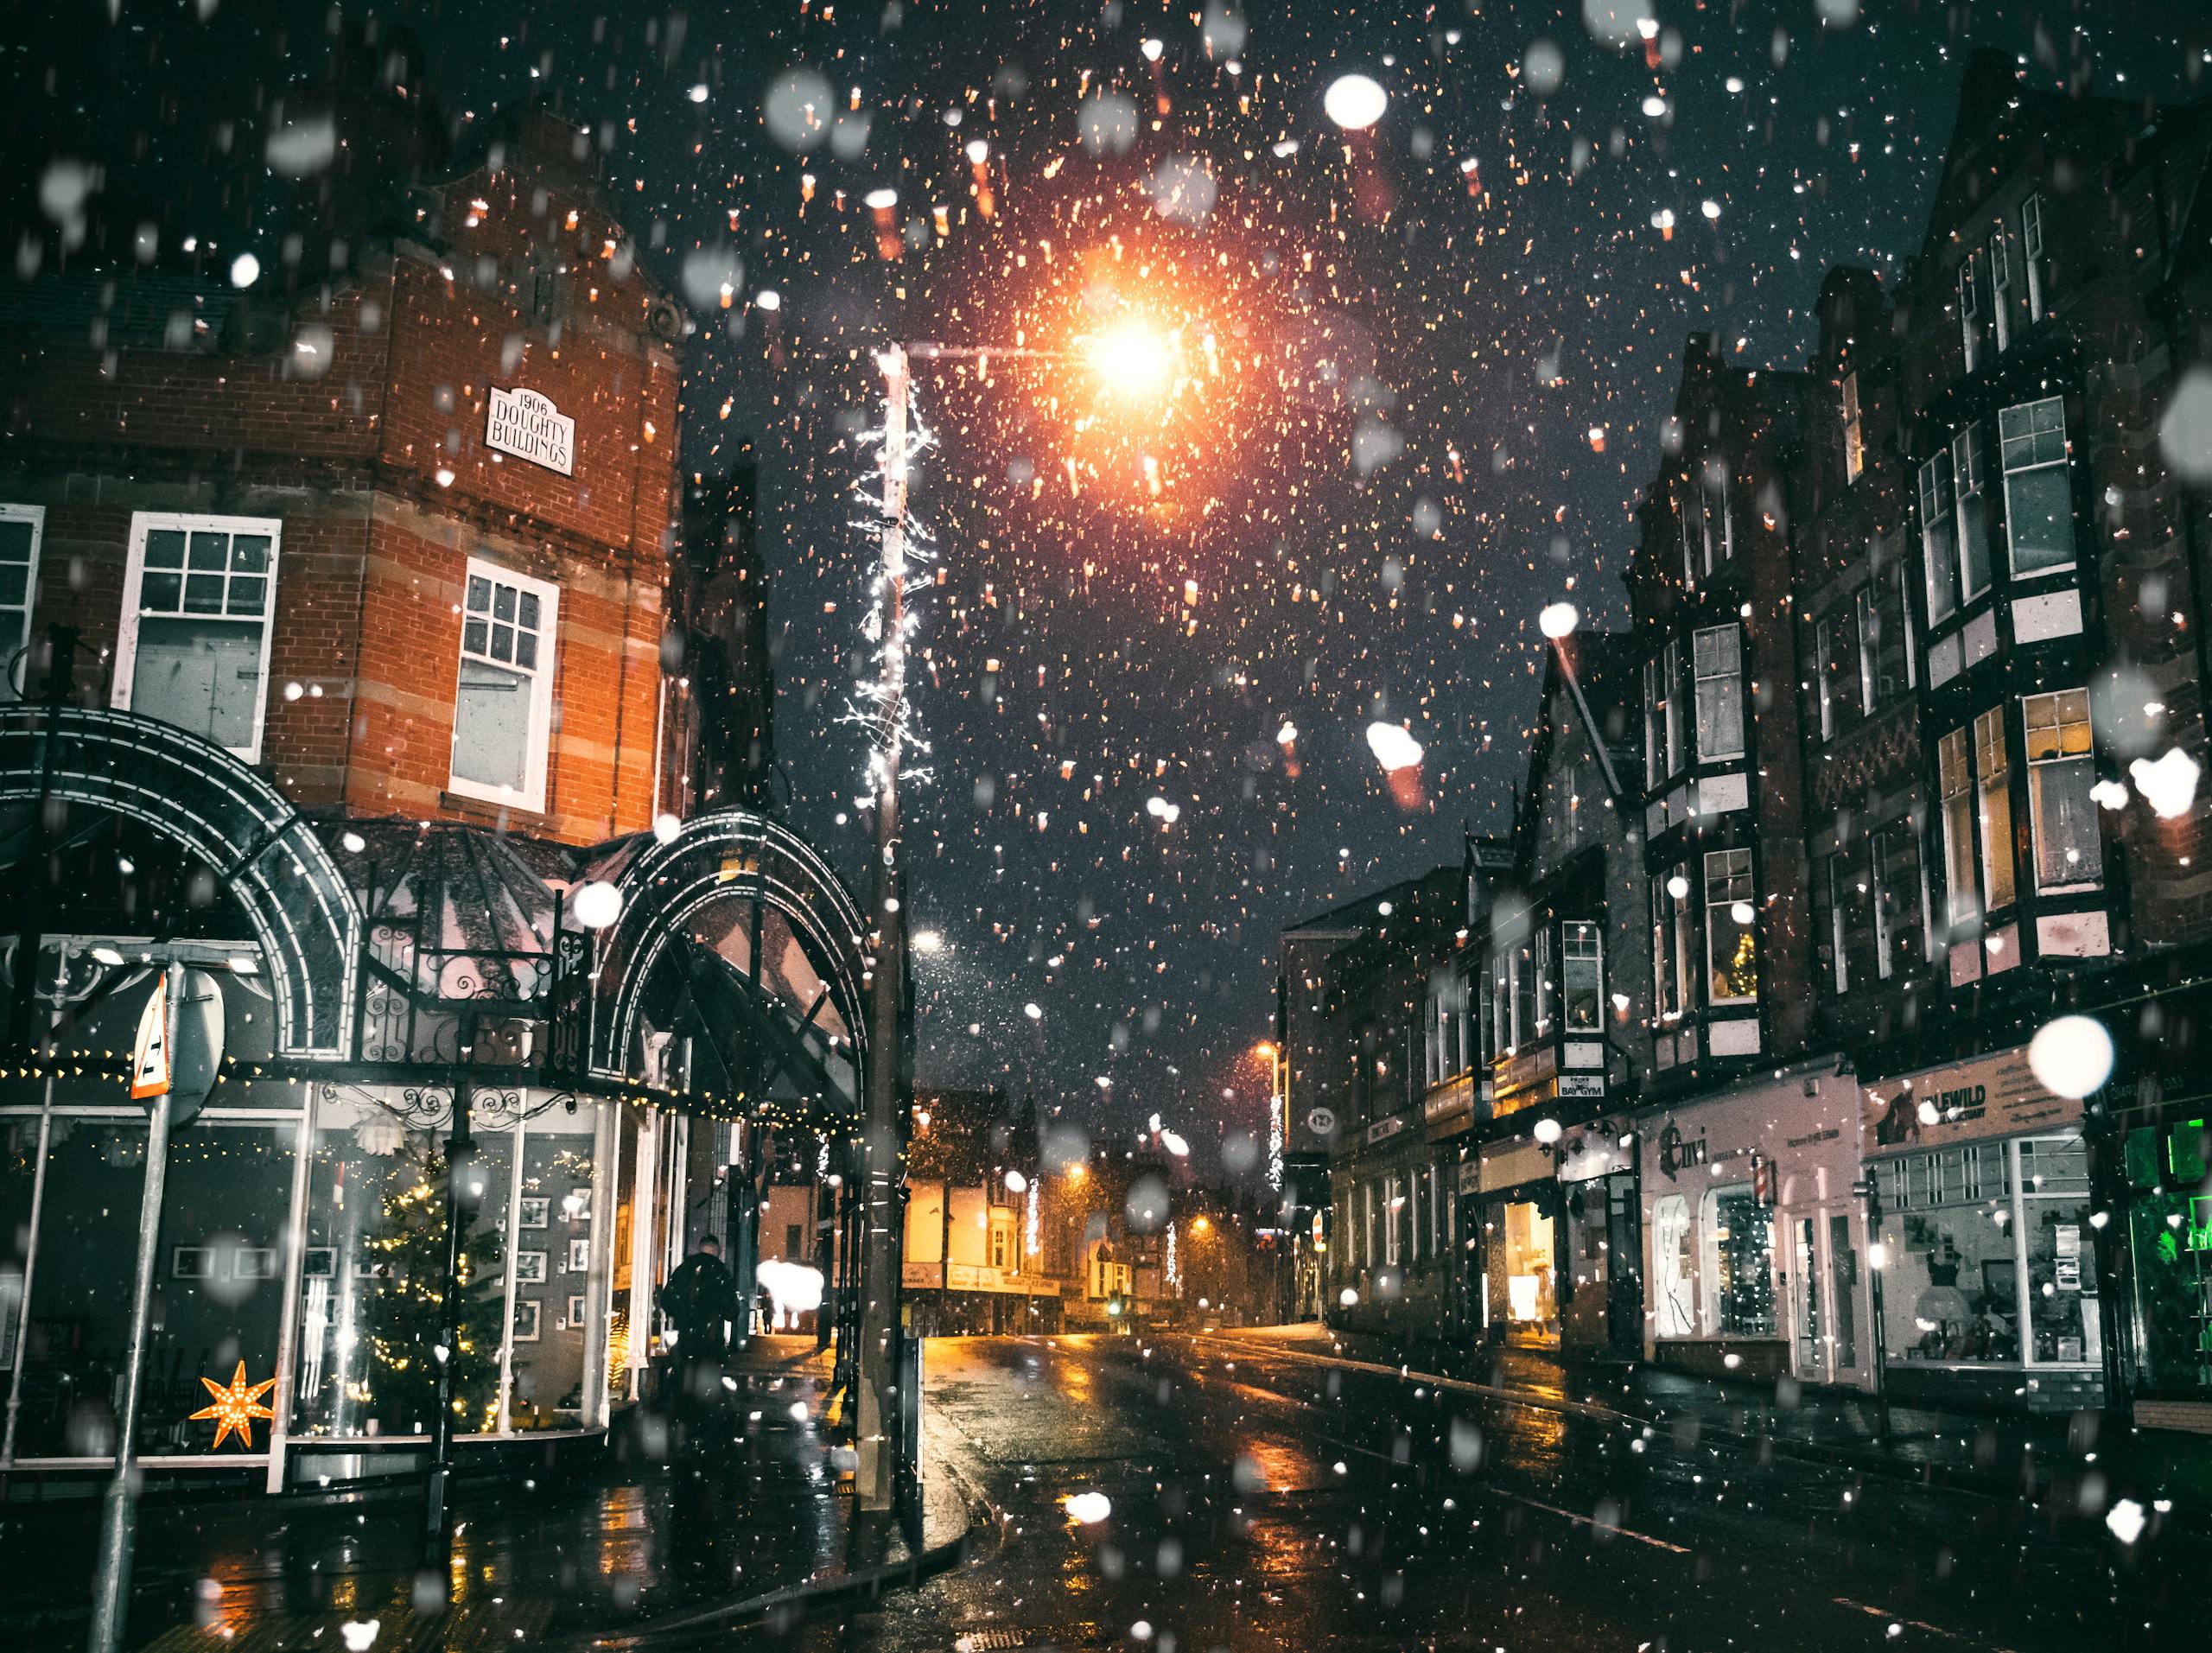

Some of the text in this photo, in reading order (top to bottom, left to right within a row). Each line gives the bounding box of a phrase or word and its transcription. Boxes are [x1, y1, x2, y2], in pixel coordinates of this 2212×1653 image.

[519, 394, 548, 416] 1906
[496, 399, 568, 444] DOUGHTY
[492, 420, 567, 467] BUILDINGS
[1561, 1086, 1601, 1096] BAY GYM
[1920, 1084, 1986, 1114] LEWILD
